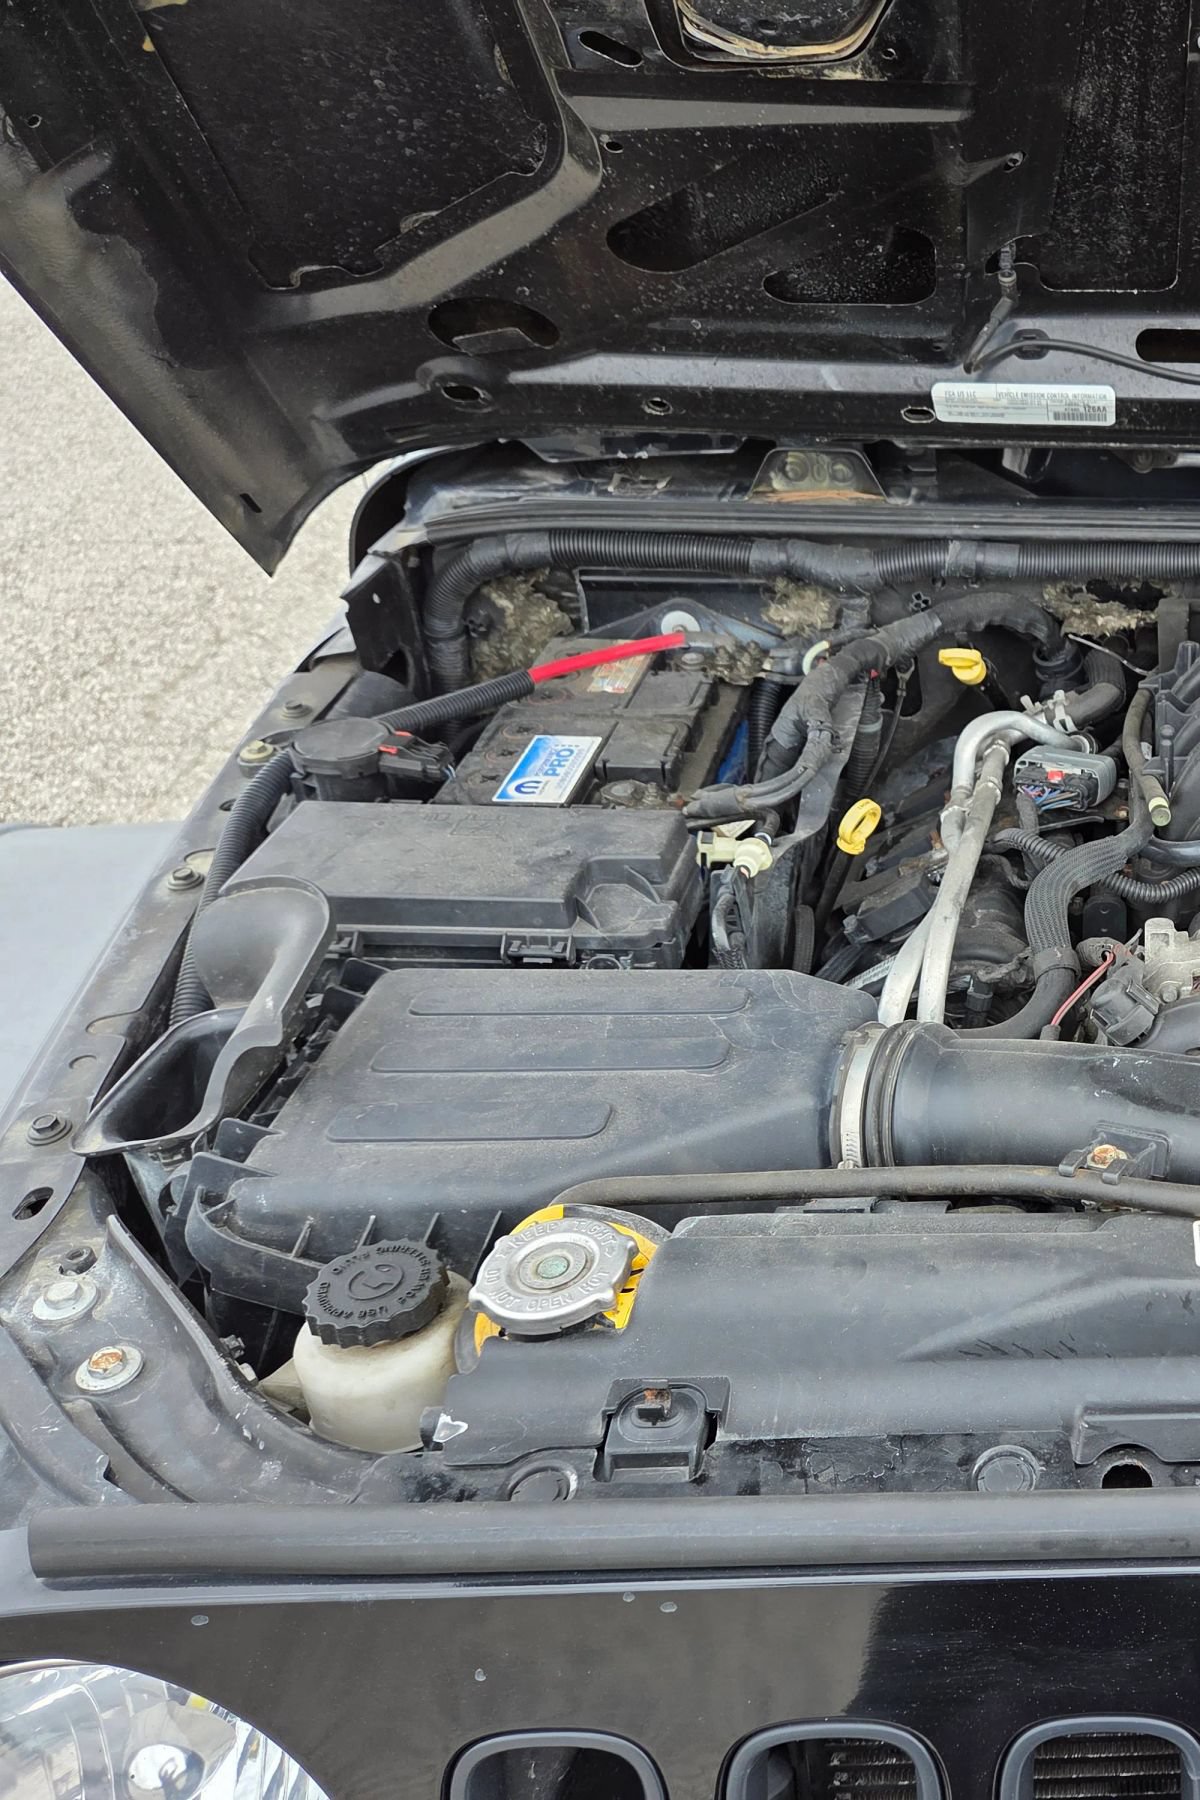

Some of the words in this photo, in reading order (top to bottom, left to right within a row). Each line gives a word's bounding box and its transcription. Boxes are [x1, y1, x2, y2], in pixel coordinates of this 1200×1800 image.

[508, 1220, 560, 1248] KEEP
[573, 1219, 617, 1246] TIGHT
[485, 1267, 501, 1285] DO
[577, 1269, 610, 1296] HOT
[316, 1281, 353, 1320] APPROVED
[488, 1290, 523, 1309] NOT
[525, 1294, 574, 1312] OPEN
